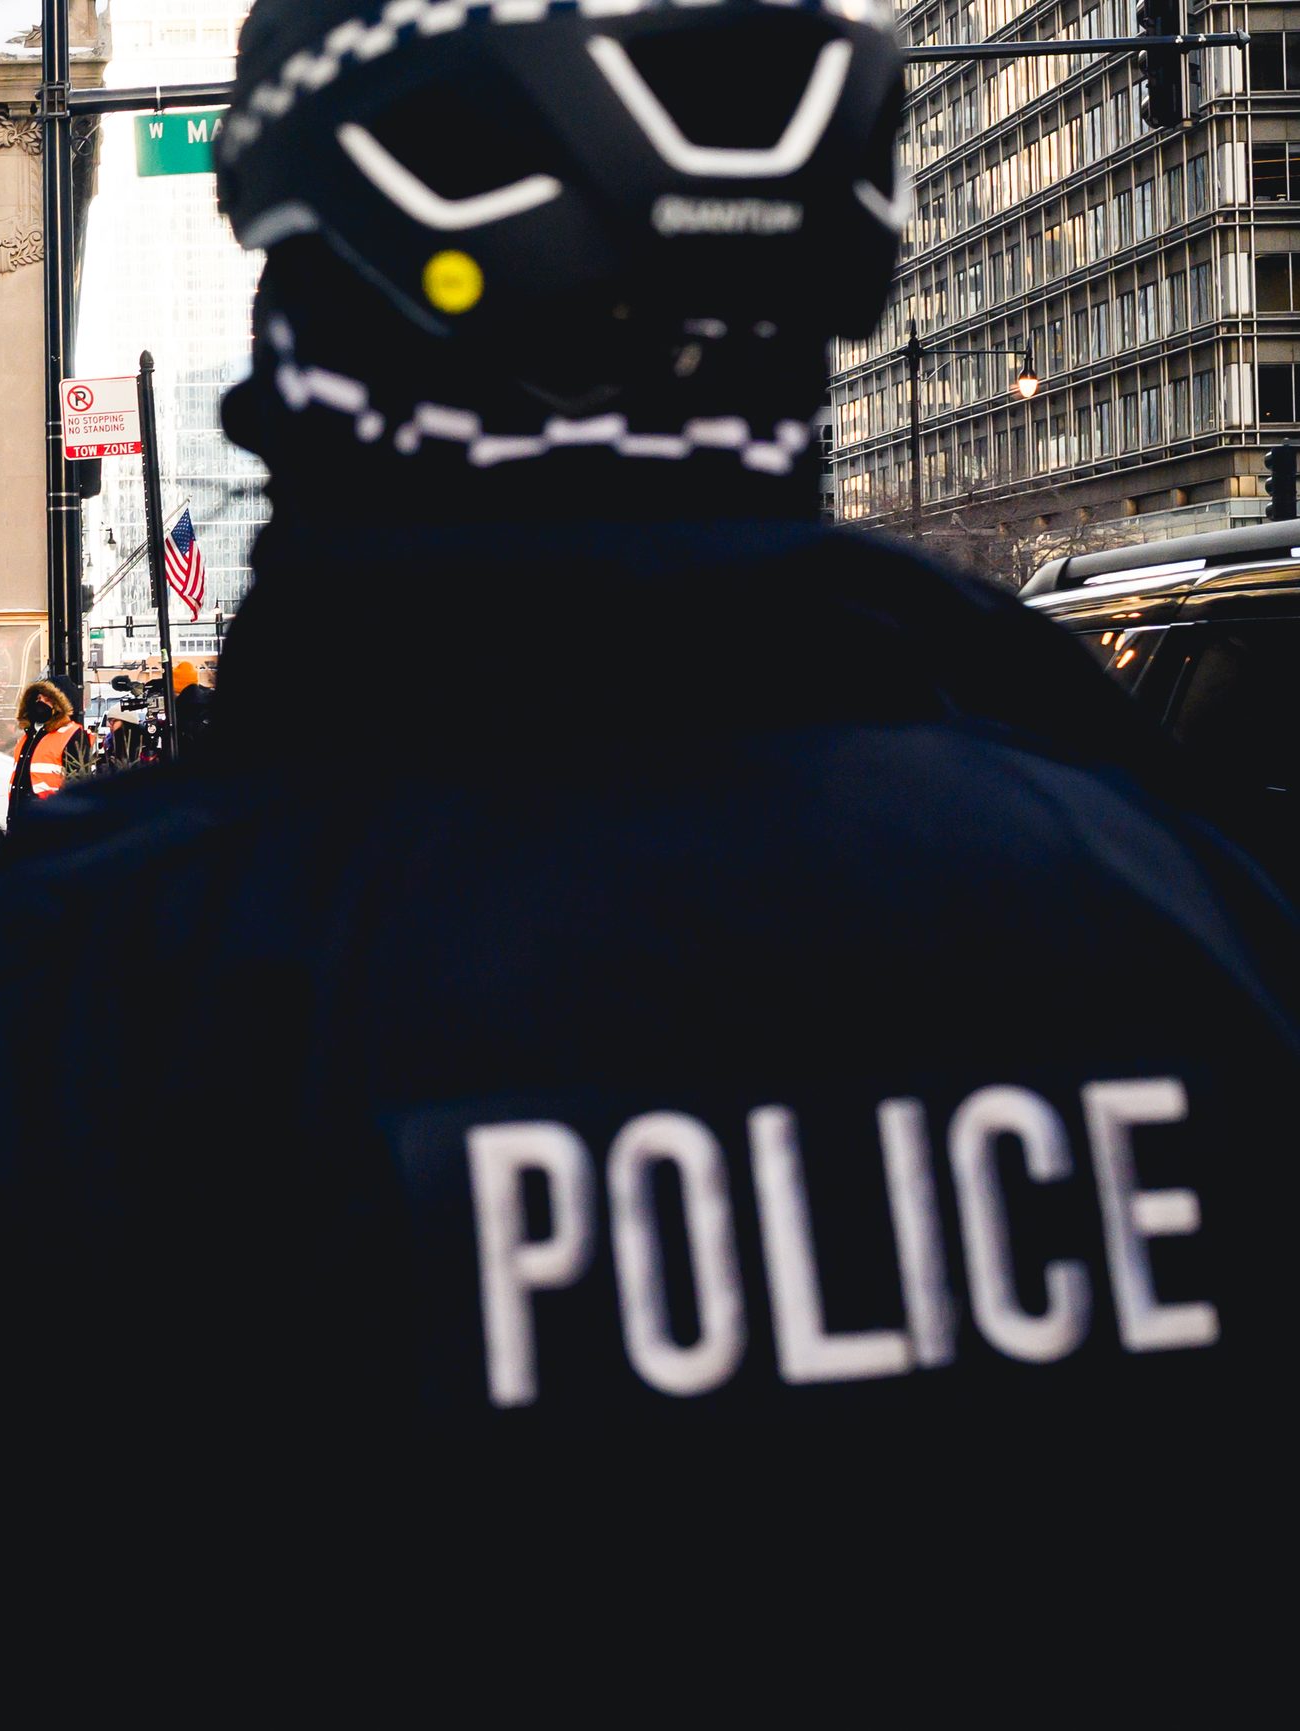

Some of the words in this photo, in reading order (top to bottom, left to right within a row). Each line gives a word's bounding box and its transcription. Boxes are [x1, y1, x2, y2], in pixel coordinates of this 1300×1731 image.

[149, 122, 163, 139] W
[83, 415, 124, 424] STOPPING
[83, 424, 125, 434] STANDING
[73, 445, 98, 457] TOW
[103, 443, 136, 455] ZONE
[466, 1076, 1220, 1408] POLICE
